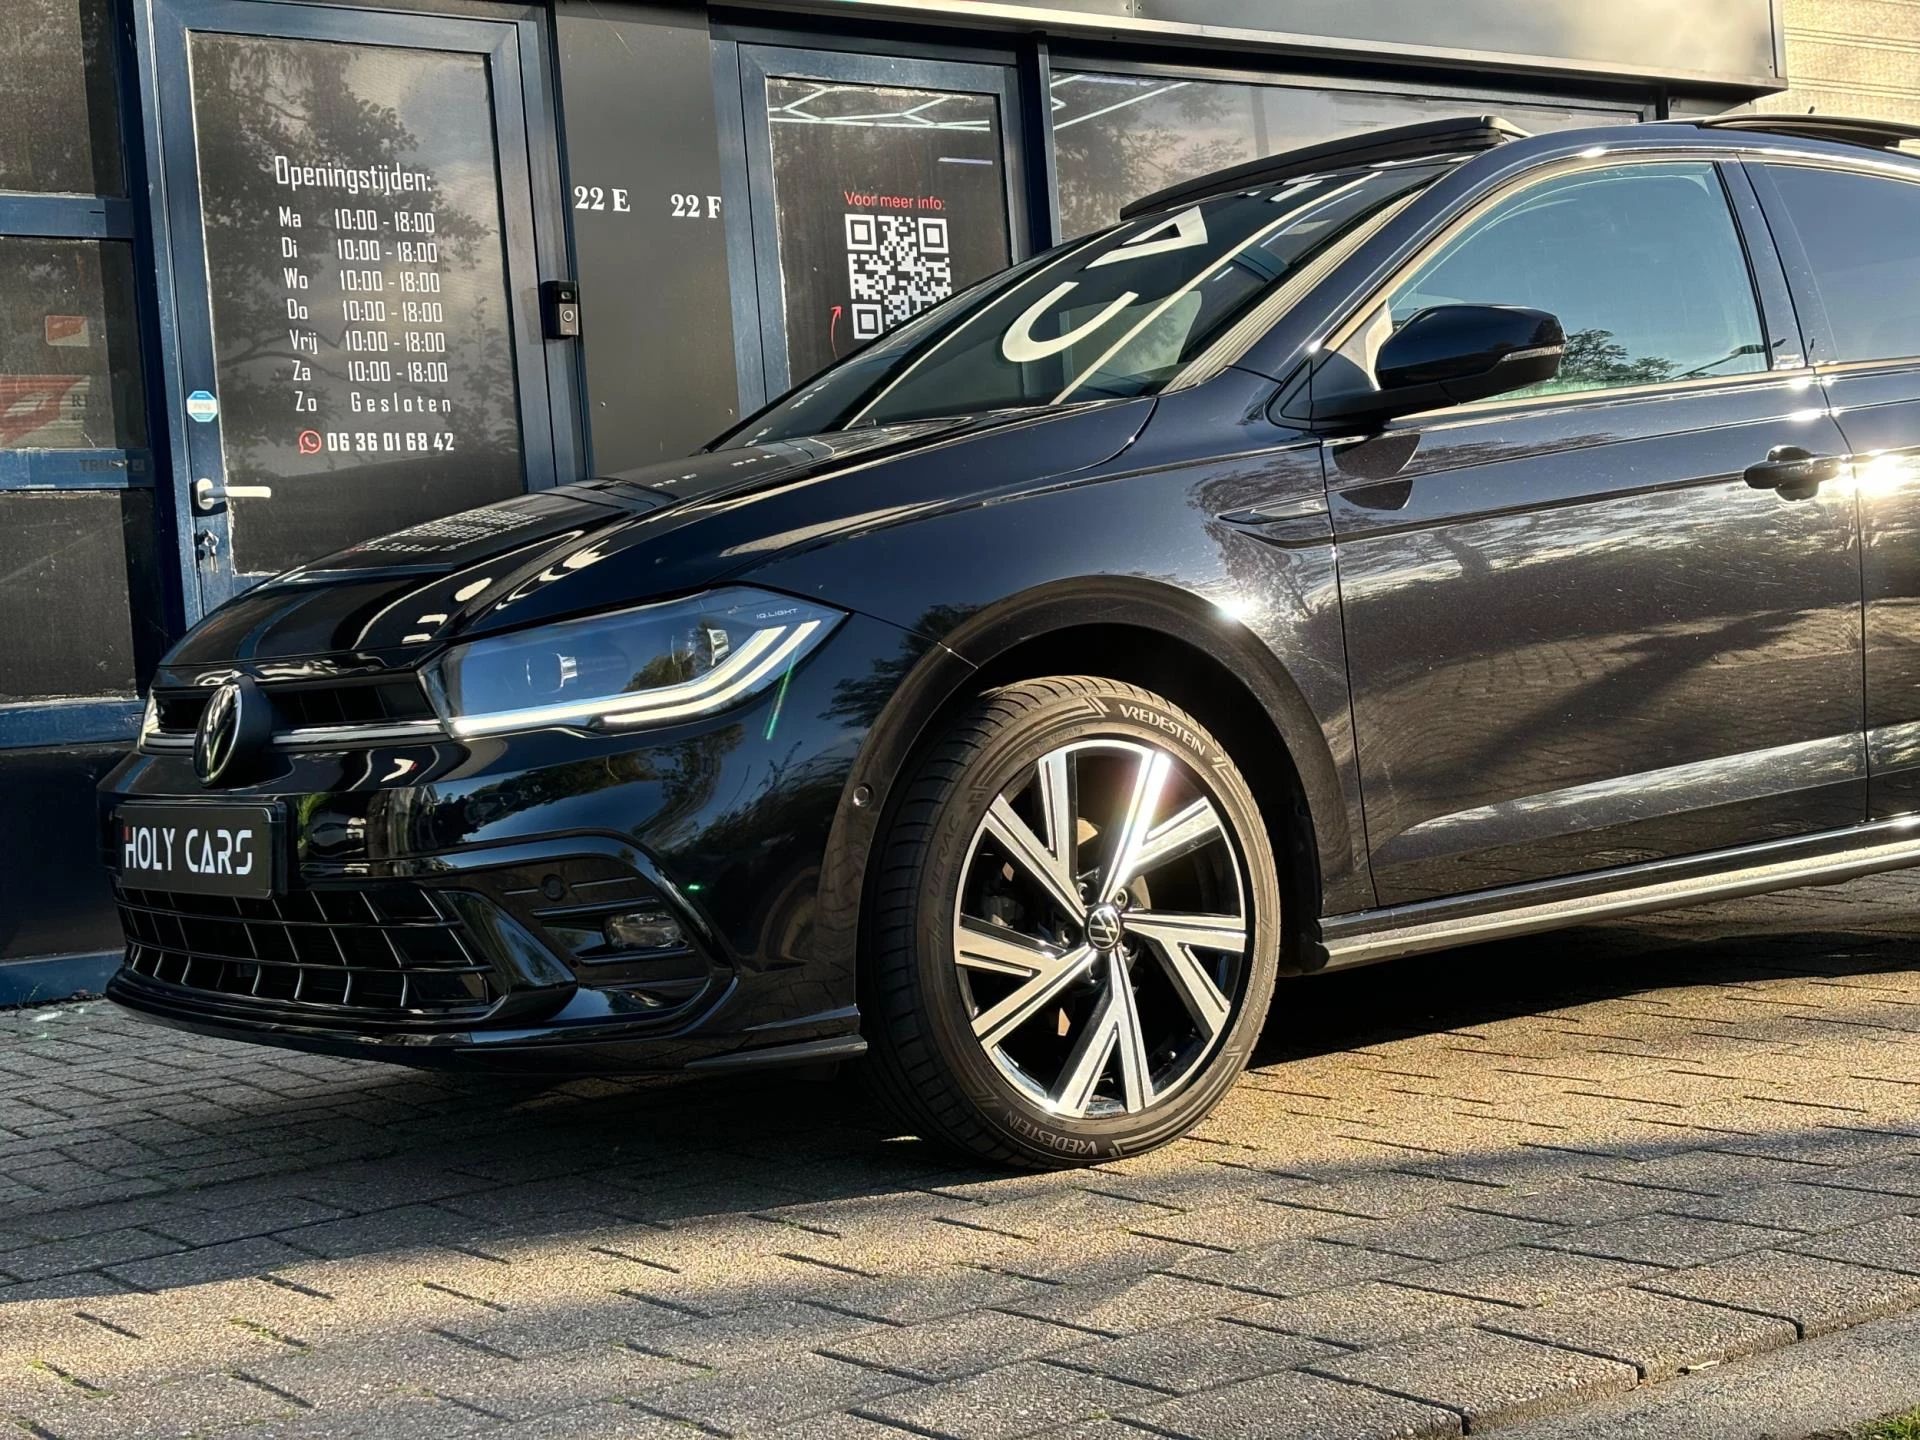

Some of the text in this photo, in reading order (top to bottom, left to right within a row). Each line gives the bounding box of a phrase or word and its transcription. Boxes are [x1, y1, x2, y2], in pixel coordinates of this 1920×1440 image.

[274, 156, 432, 195] Openingstijden:
[574, 186, 631, 212] 22 E
[670, 194, 722, 218] 22 F
[844, 191, 946, 210] Voor meer info:
[279, 206, 302, 228] Ma
[335, 208, 378, 230] 10:00
[394, 211, 436, 233] 18:00
[282, 237, 298, 258] Di
[338, 239, 380, 261] 10:00
[397, 241, 438, 263] 18:00
[284, 268, 308, 289] Wo
[340, 270, 383, 291] 10:00
[400, 272, 440, 292] 18:00
[287, 298, 308, 319] Do
[343, 300, 386, 322] 10:00
[402, 302, 443, 322] 18:00
[289, 329, 318, 355] Vrij
[346, 330, 388, 352] 10:00
[405, 332, 446, 352] 18:00
[292, 360, 311, 381] Za
[348, 361, 391, 382] 10:00
[408, 362, 448, 382] 18:00
[294, 391, 451, 412] Zo Gesloten
[326, 432, 455, 452] 06 36 01 68 42
[1119, 704, 1206, 756] VREDESTEIN
[123, 826, 253, 875] HOLY CARS
[1004, 1110, 1098, 1155] VREDESTEIN
